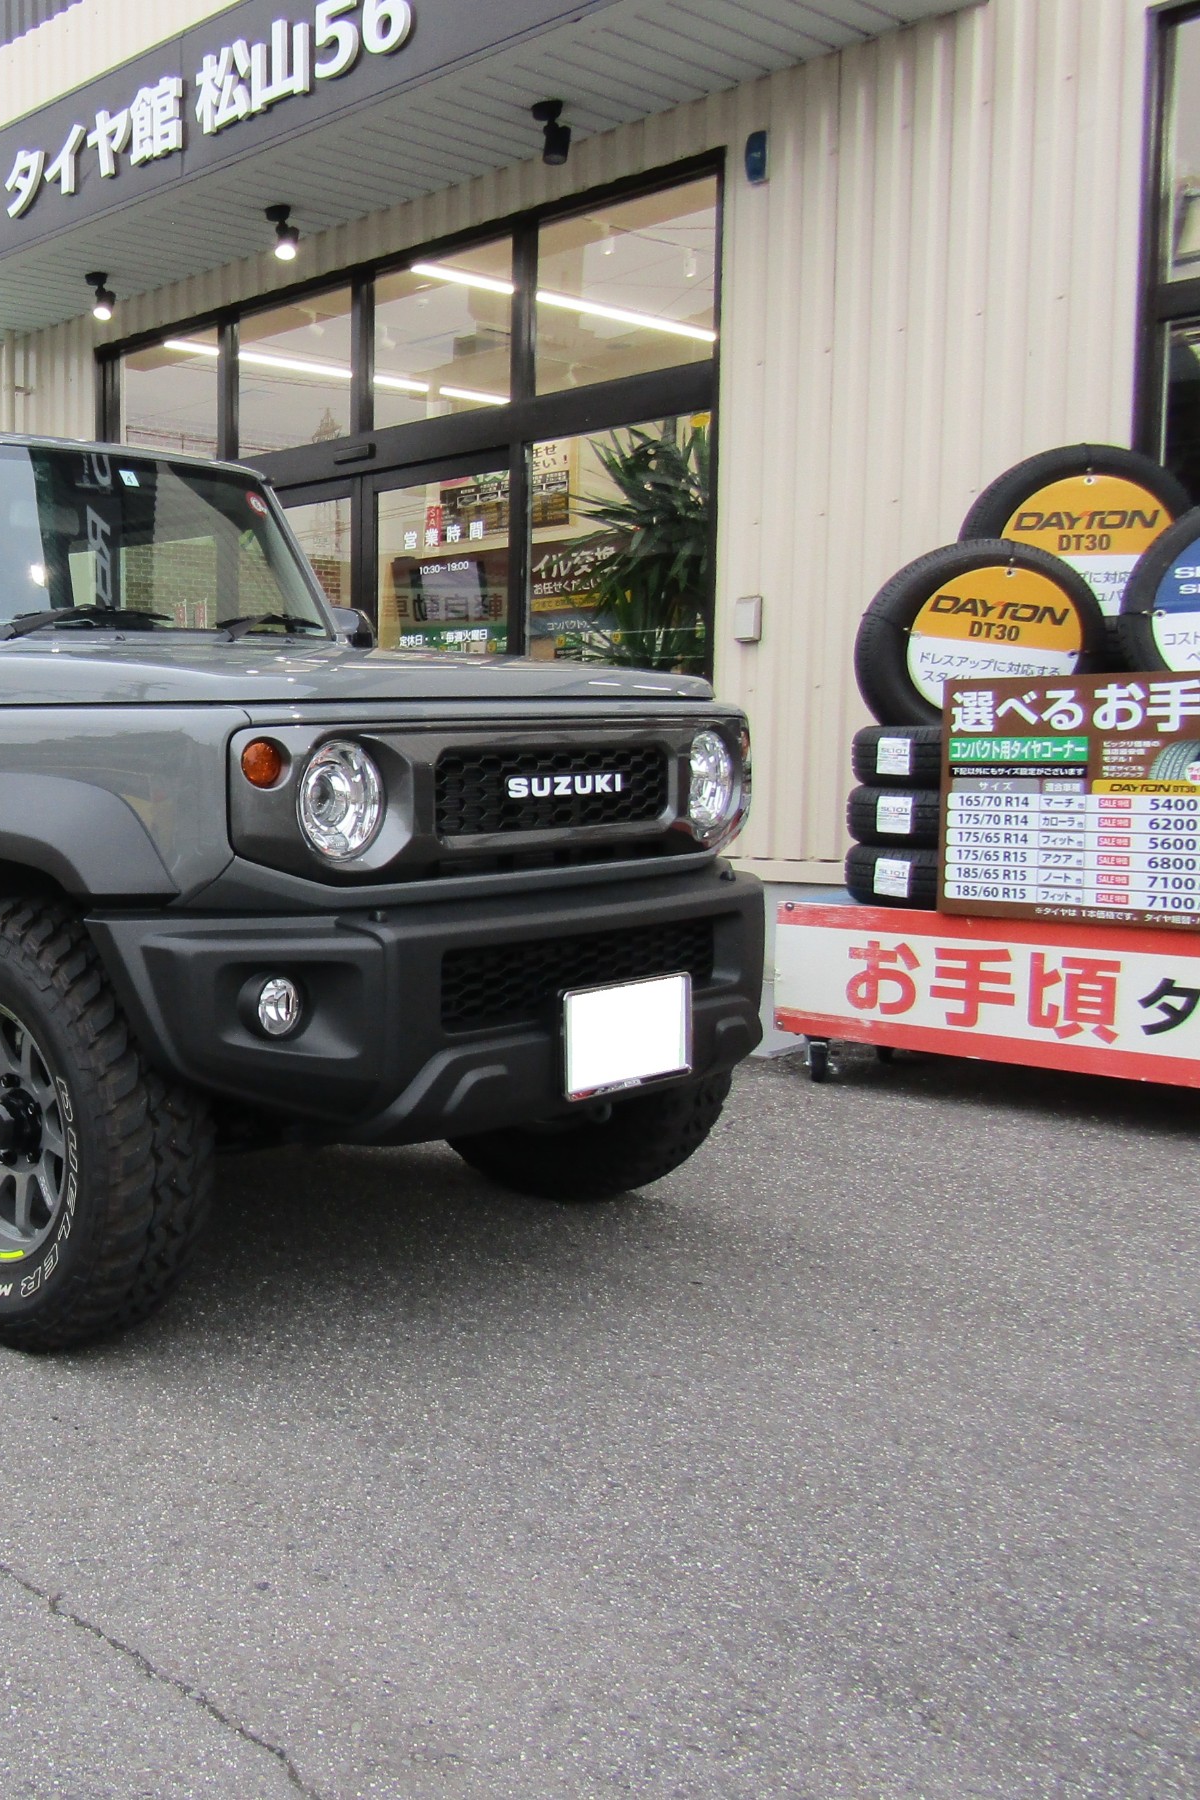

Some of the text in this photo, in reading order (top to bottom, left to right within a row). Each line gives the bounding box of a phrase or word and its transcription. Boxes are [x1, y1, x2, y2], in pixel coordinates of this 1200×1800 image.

[4, 0, 411, 219] タイヤ館 松山56
[1013, 509, 1160, 531] DAYTON
[403, 521, 483, 550] 営業時間
[1057, 534, 1111, 552] DT30
[928, 594, 1071, 627] DAYTON
[968, 620, 1020, 642] DT30
[951, 739, 1087, 760] コンパクト用タイヤコーナー
[507, 773, 622, 798] SUZUKI
[978, 781, 1013, 791] サイズ
[1109, 783, 1172, 793] DAYTON
[958, 795, 1030, 808] 165/70 R14
[1043, 798, 1075, 808] マーチ
[1148, 798, 1198, 811] 5400
[958, 813, 1029, 826] 175/70 R14
[1042, 816, 1076, 827] カローラ
[1148, 818, 1198, 831] 6200
[957, 831, 1028, 844] 175/65 R14
[1041, 835, 1075, 845] フィット
[1147, 837, 1197, 851] 5600
[956, 849, 1027, 863] 175/65 R15
[1041, 853, 1073, 864] アクア
[1147, 857, 1196, 870] 6800
[955, 867, 1027, 881] 185/65 R15
[1042, 872, 1072, 882] ノート
[1146, 875, 1196, 890] 7100
[955, 885, 1026, 900] 185/60 R15
[1041, 891, 1072, 900] フィット
[1146, 895, 1195, 910] 7100
